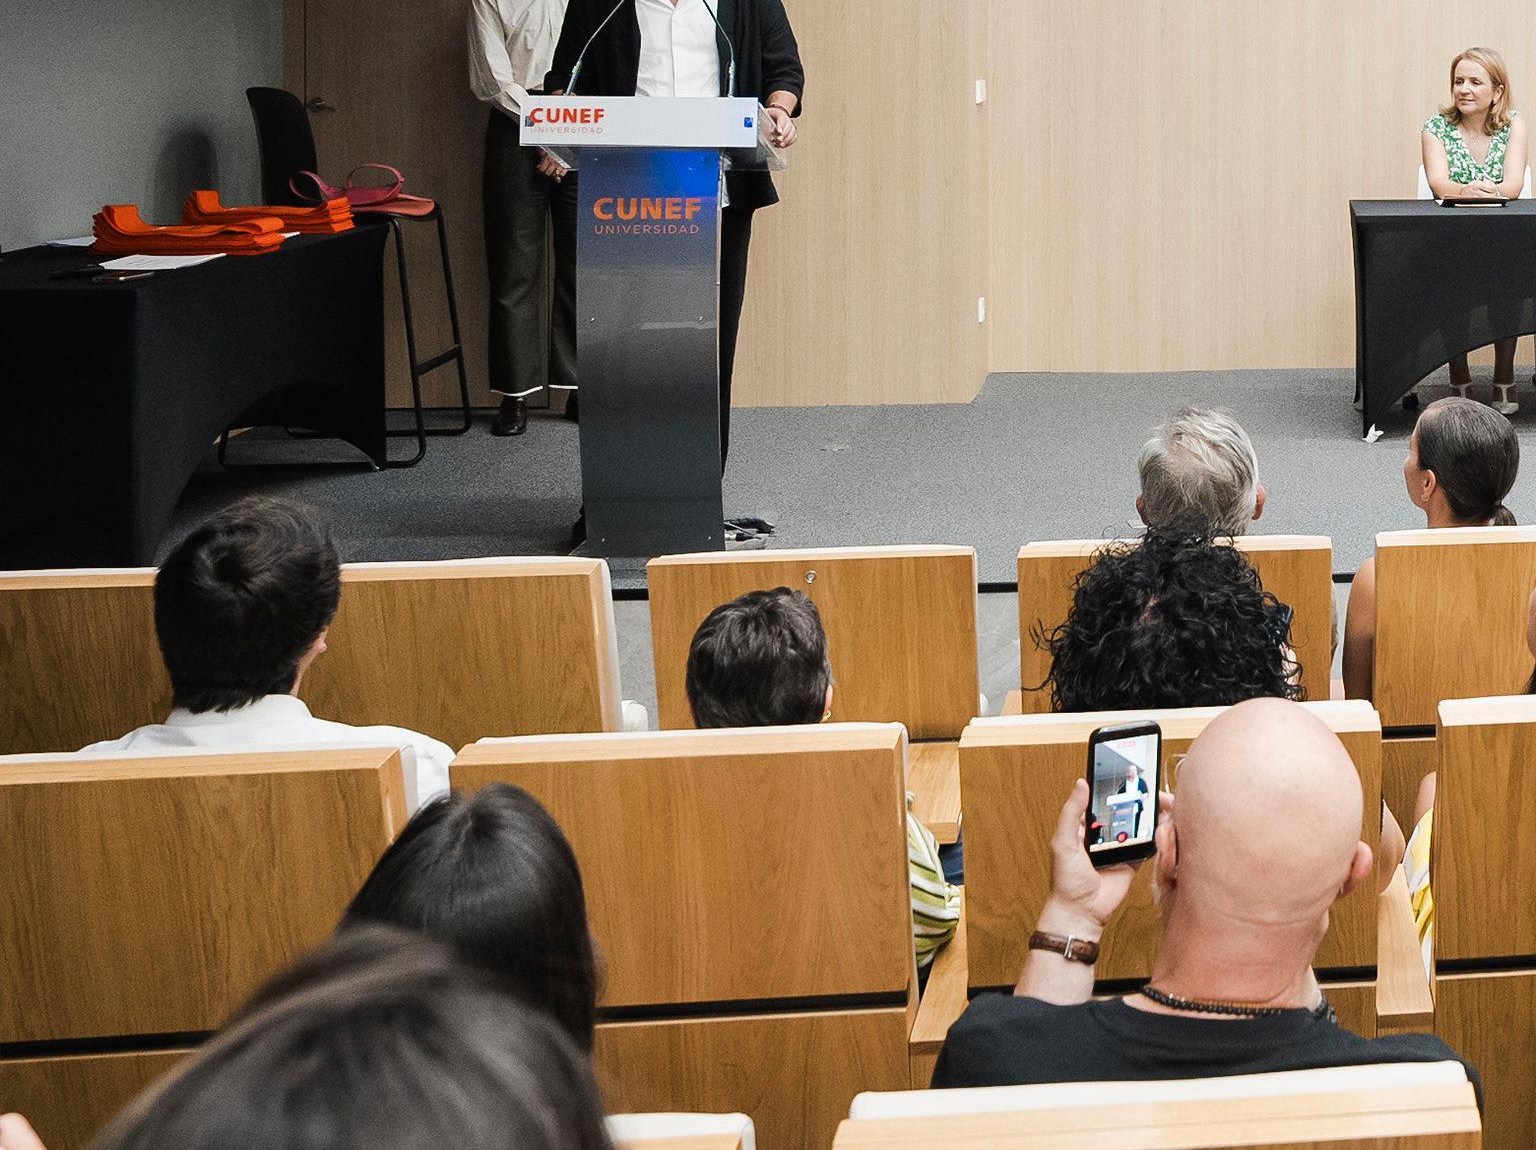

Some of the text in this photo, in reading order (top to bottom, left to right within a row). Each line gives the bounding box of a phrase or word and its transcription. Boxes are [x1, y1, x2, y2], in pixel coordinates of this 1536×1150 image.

[529, 107, 605, 124] CUNEF
[530, 126, 604, 134] UNIVERSIDAD
[593, 196, 702, 221] CUNEF
[594, 224, 700, 235] UNIVERSIDAD
